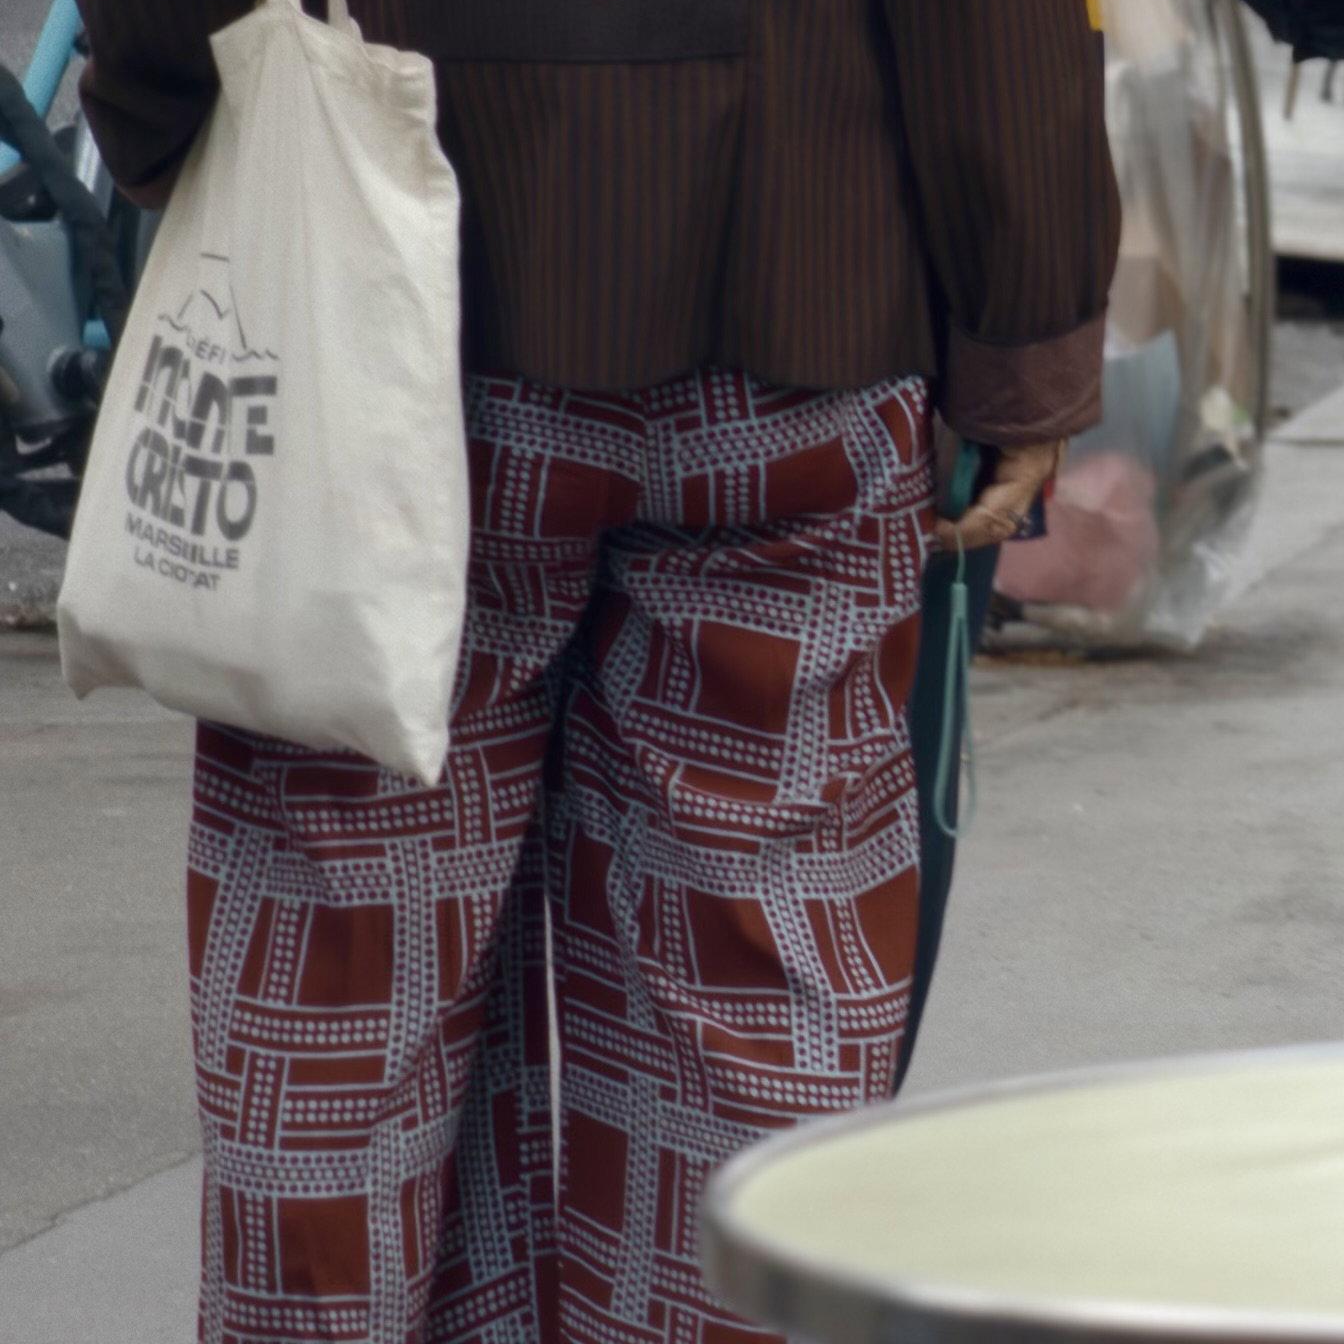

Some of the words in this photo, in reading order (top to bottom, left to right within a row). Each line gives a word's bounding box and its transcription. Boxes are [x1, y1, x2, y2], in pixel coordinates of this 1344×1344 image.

[134, 335, 278, 455] MONE
[133, 545, 155, 571] LA
[157, 557, 222, 591] CIOAT
